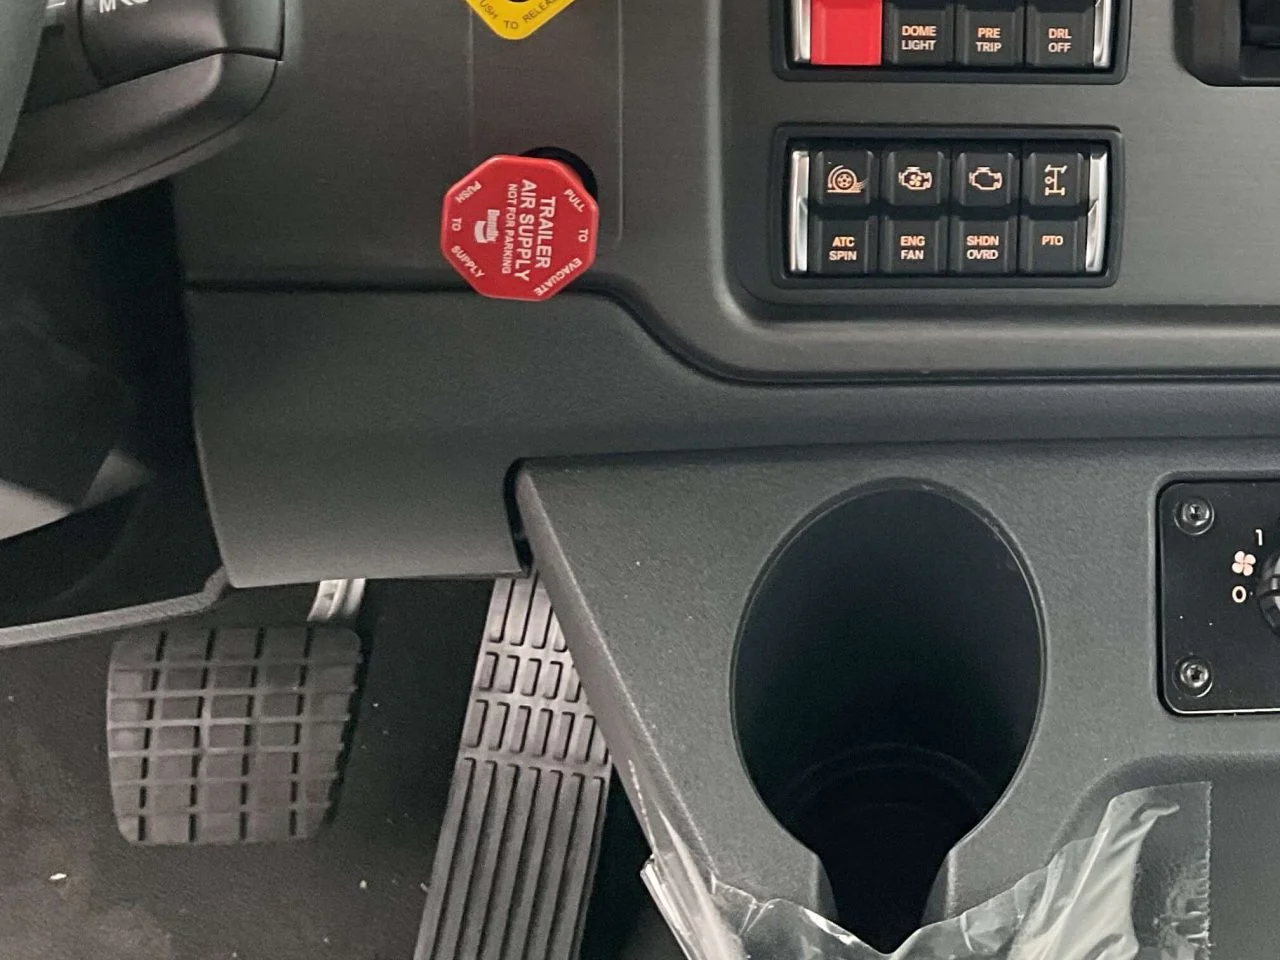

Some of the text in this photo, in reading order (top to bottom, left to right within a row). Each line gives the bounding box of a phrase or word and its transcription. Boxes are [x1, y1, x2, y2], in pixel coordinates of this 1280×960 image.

[504, 20, 519, 30] TO
[902, 25, 937, 37] DOME
[977, 27, 1000, 38] PRE
[1048, 28, 1072, 39] DRL
[902, 39, 936, 51] LIGHT
[976, 42, 1001, 53] TRIP
[1048, 42, 1072, 53] OFF
[451, 181, 485, 278] PUSH TO SUPPLY
[502, 184, 518, 274] NOT FOR PARKING
[515, 180, 537, 281] AIR SUPPLY
[535, 196, 556, 268] TRAILER
[534, 189, 588, 297] PULL TO EVACUATE
[832, 236, 855, 247] ATC
[900, 236, 925, 247] ENG
[966, 236, 999, 246] SHDN
[1041, 236, 1063, 246] PTO
[828, 250, 857, 261] SPIN
[901, 249, 924, 260] FAN
[967, 249, 999, 260] OVRD
[1255, 529, 1263, 546] 1
[1231, 585, 1247, 603] 0
